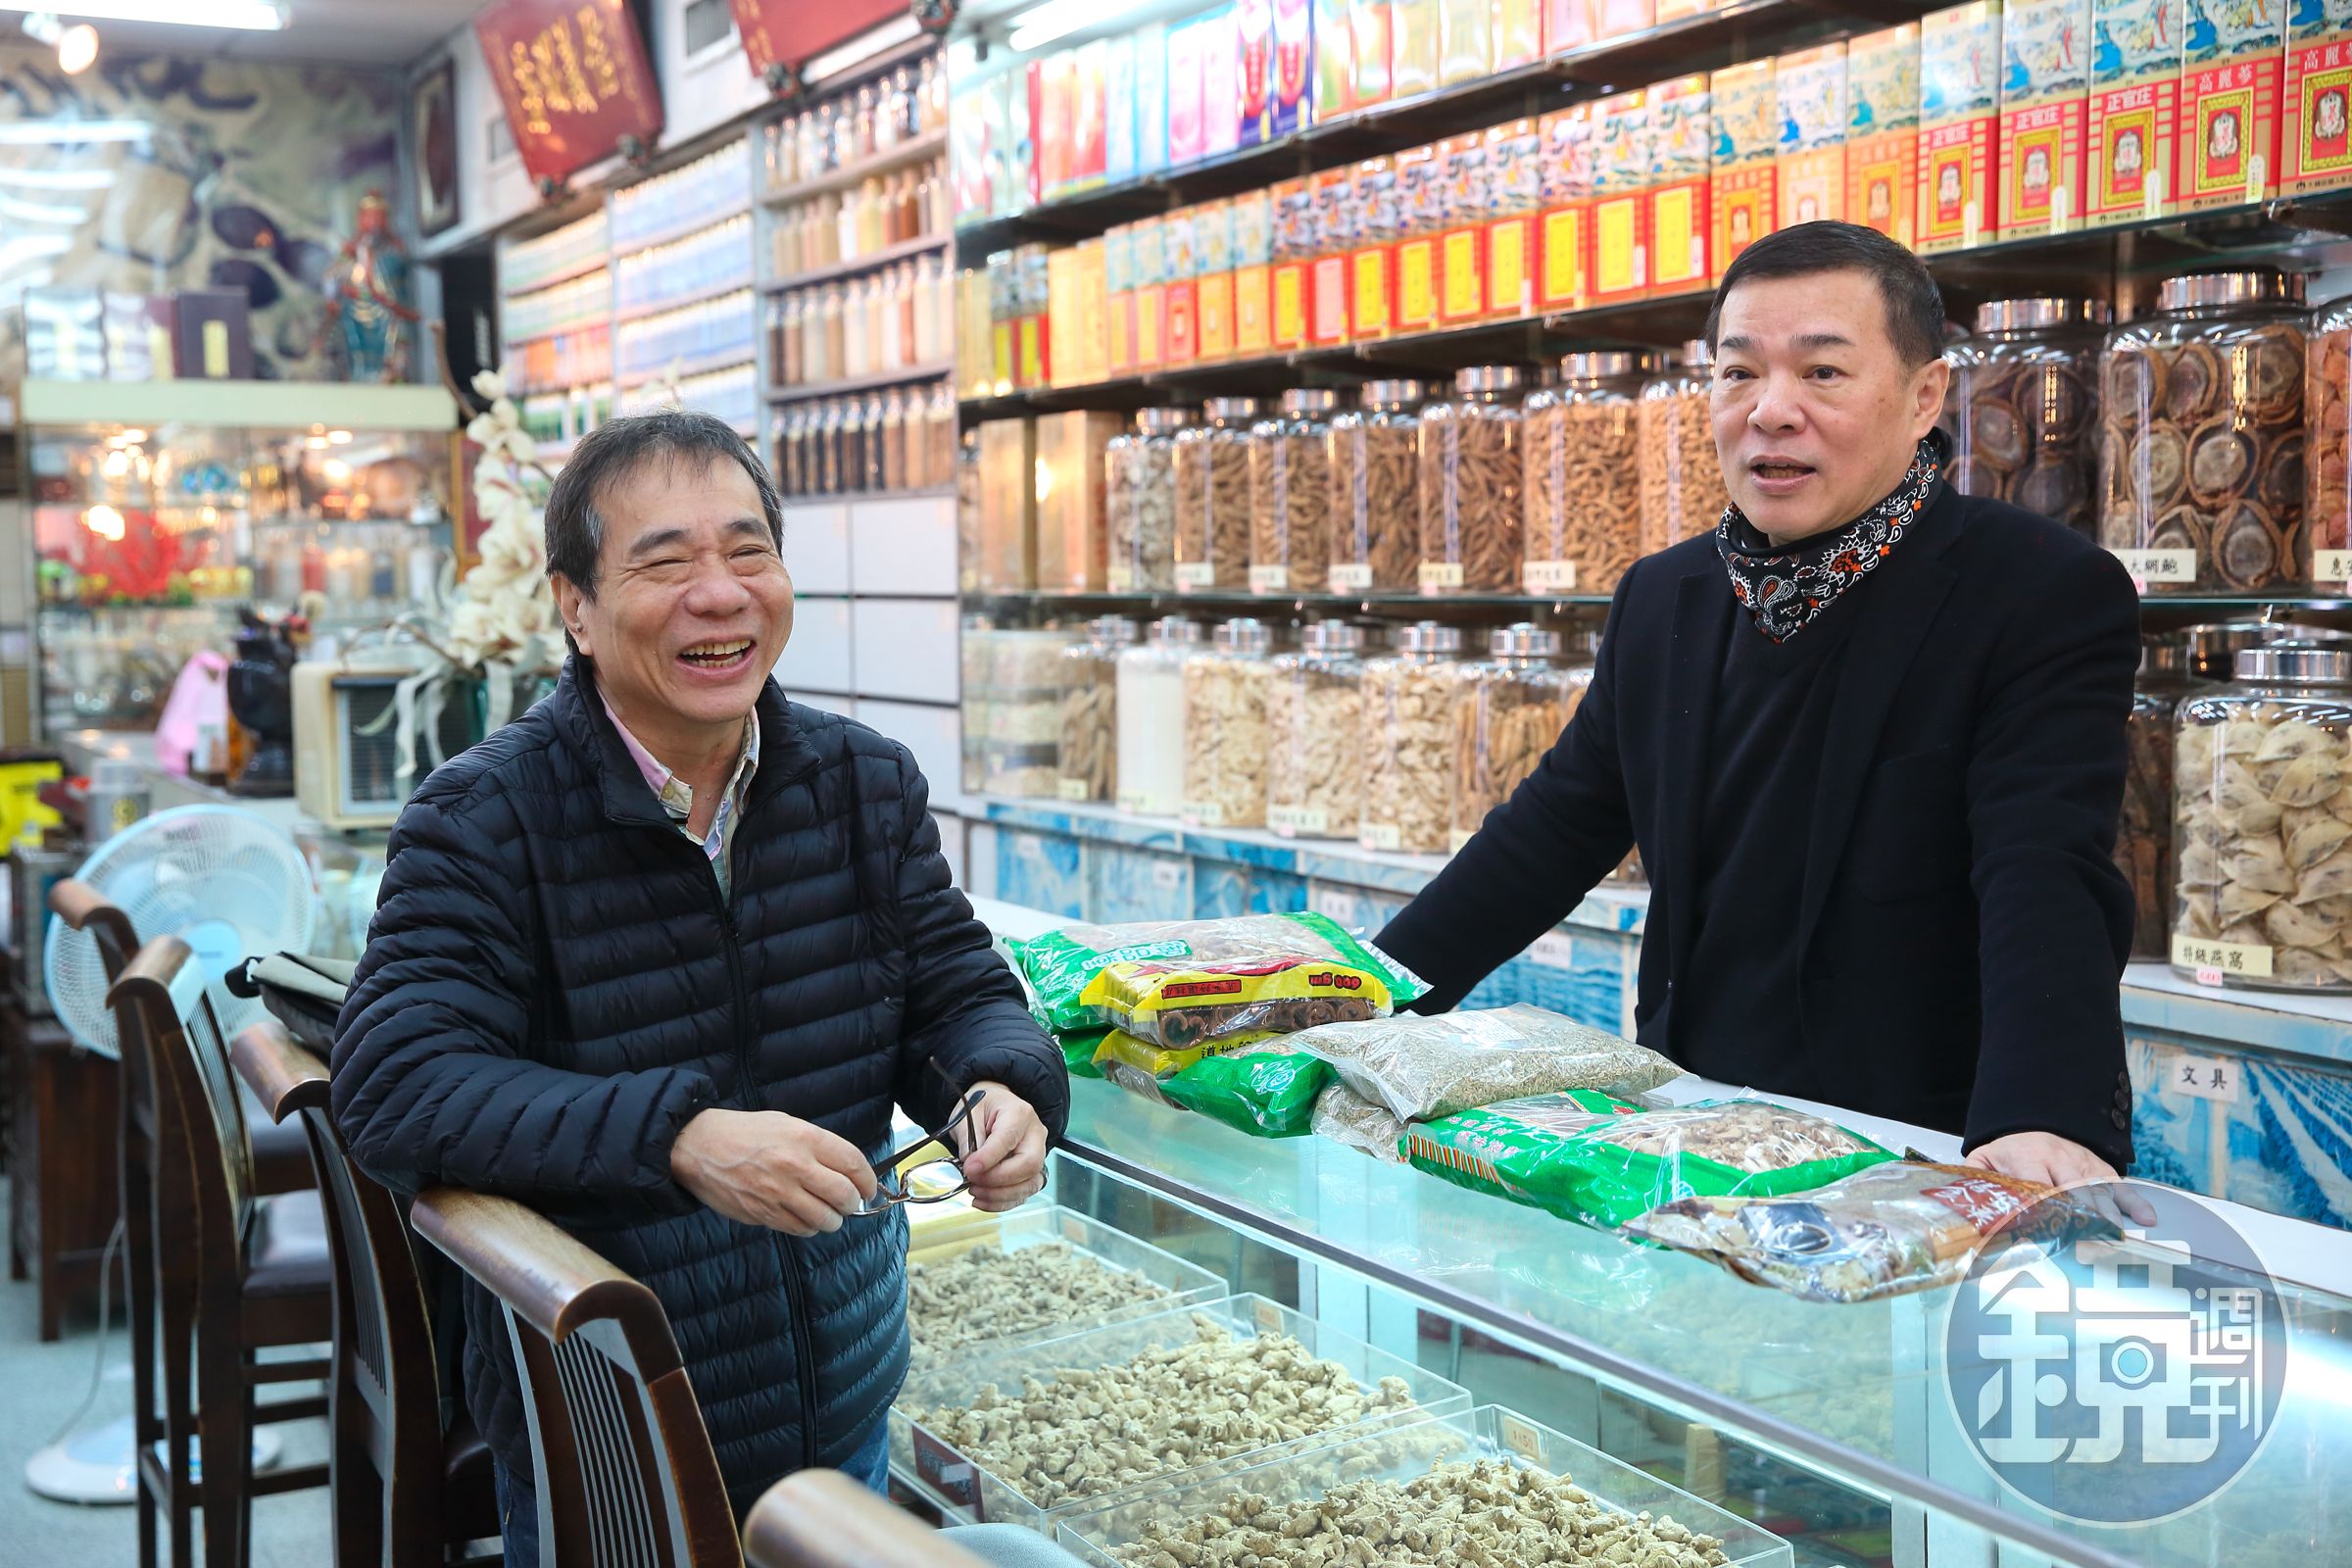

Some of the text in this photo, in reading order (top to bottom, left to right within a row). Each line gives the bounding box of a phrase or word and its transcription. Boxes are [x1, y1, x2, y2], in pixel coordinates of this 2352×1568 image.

[2107, 86, 2153, 112] 正官庄
[2181, 1063, 2228, 1090] 文具
